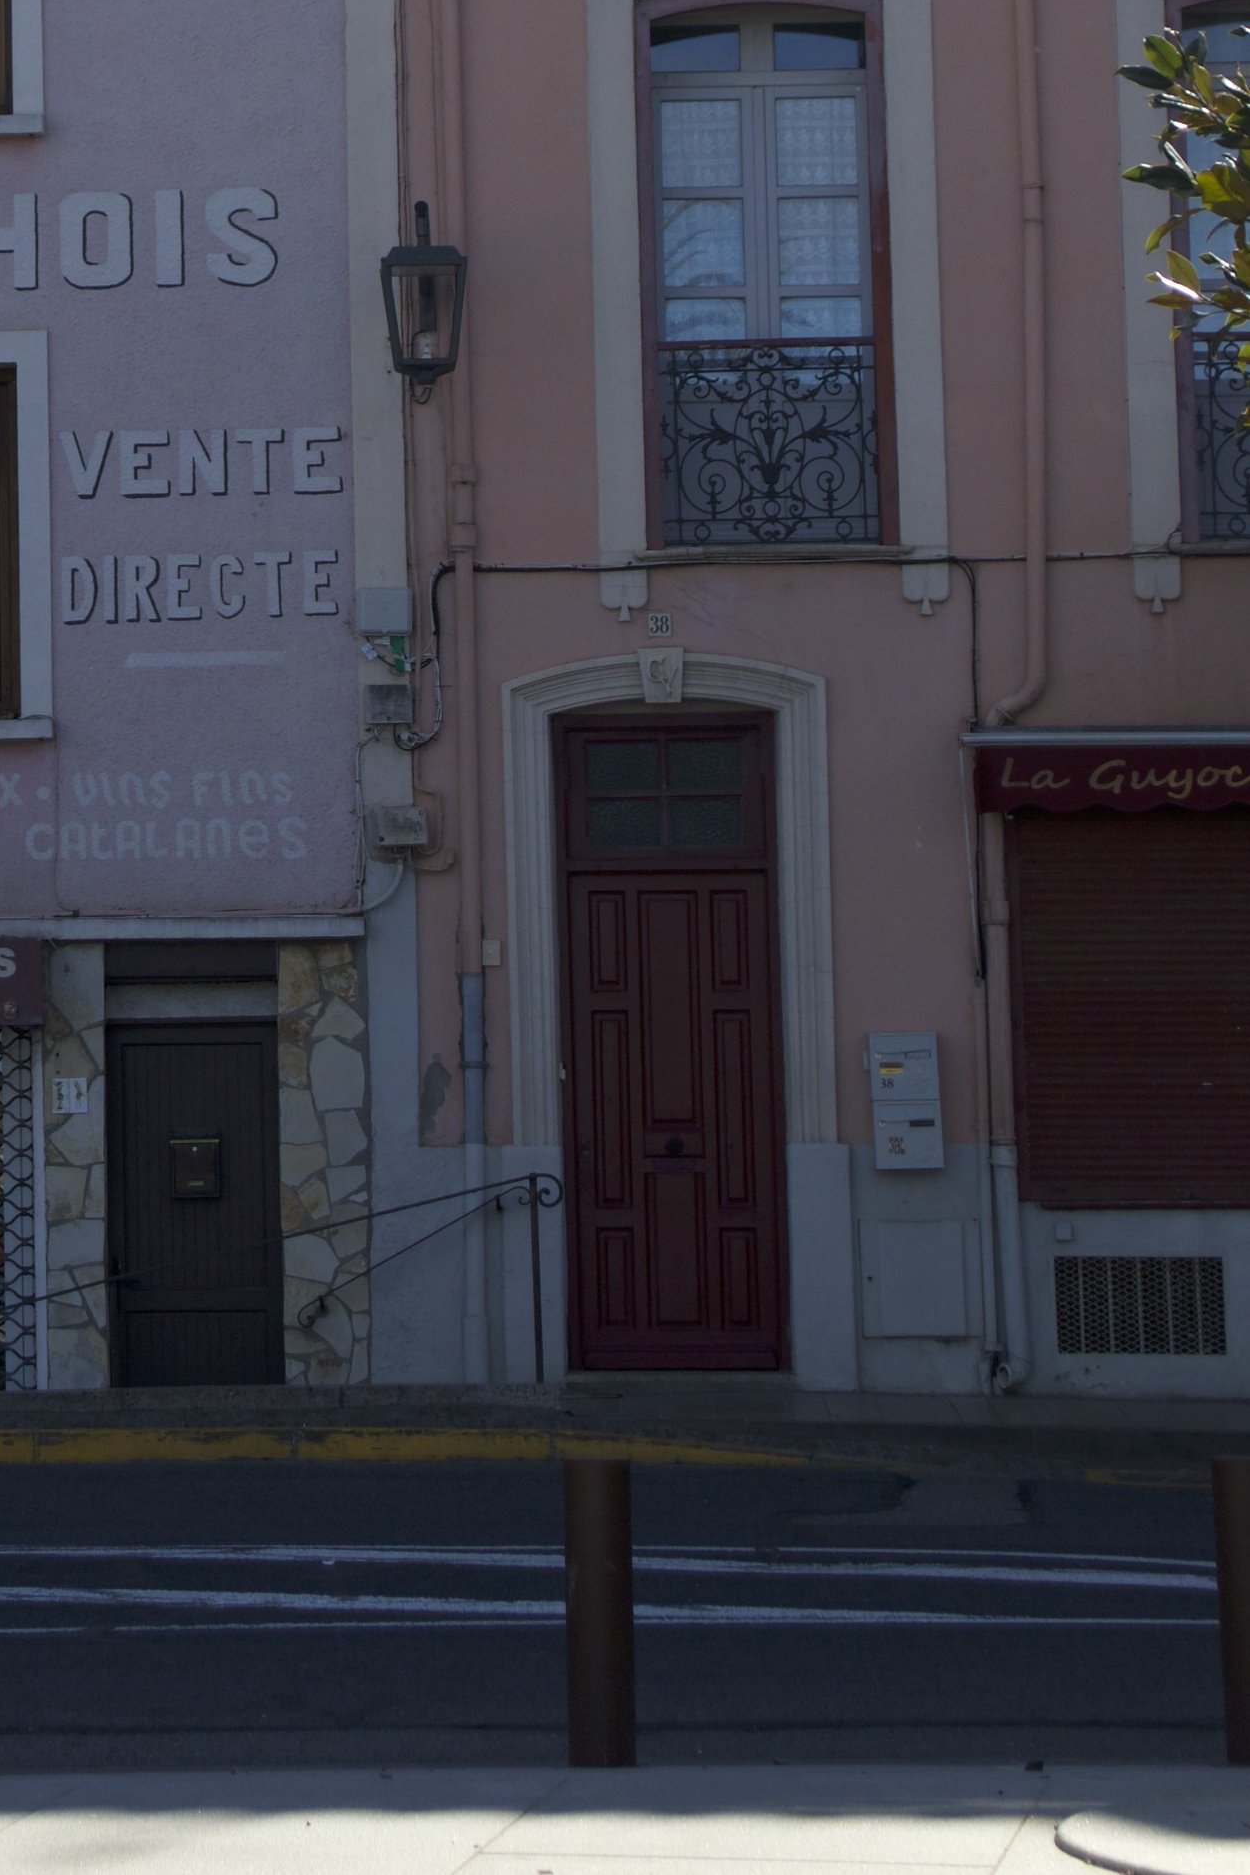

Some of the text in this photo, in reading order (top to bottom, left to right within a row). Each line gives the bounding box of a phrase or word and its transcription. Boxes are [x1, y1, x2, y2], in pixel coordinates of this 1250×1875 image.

[59, 425, 344, 500] VENTE
[60, 548, 340, 626] DIRECTE
[650, 614, 670, 634] 38
[1001, 756, 1250, 800] La Guyoc
[880, 1078, 895, 1089] 38
